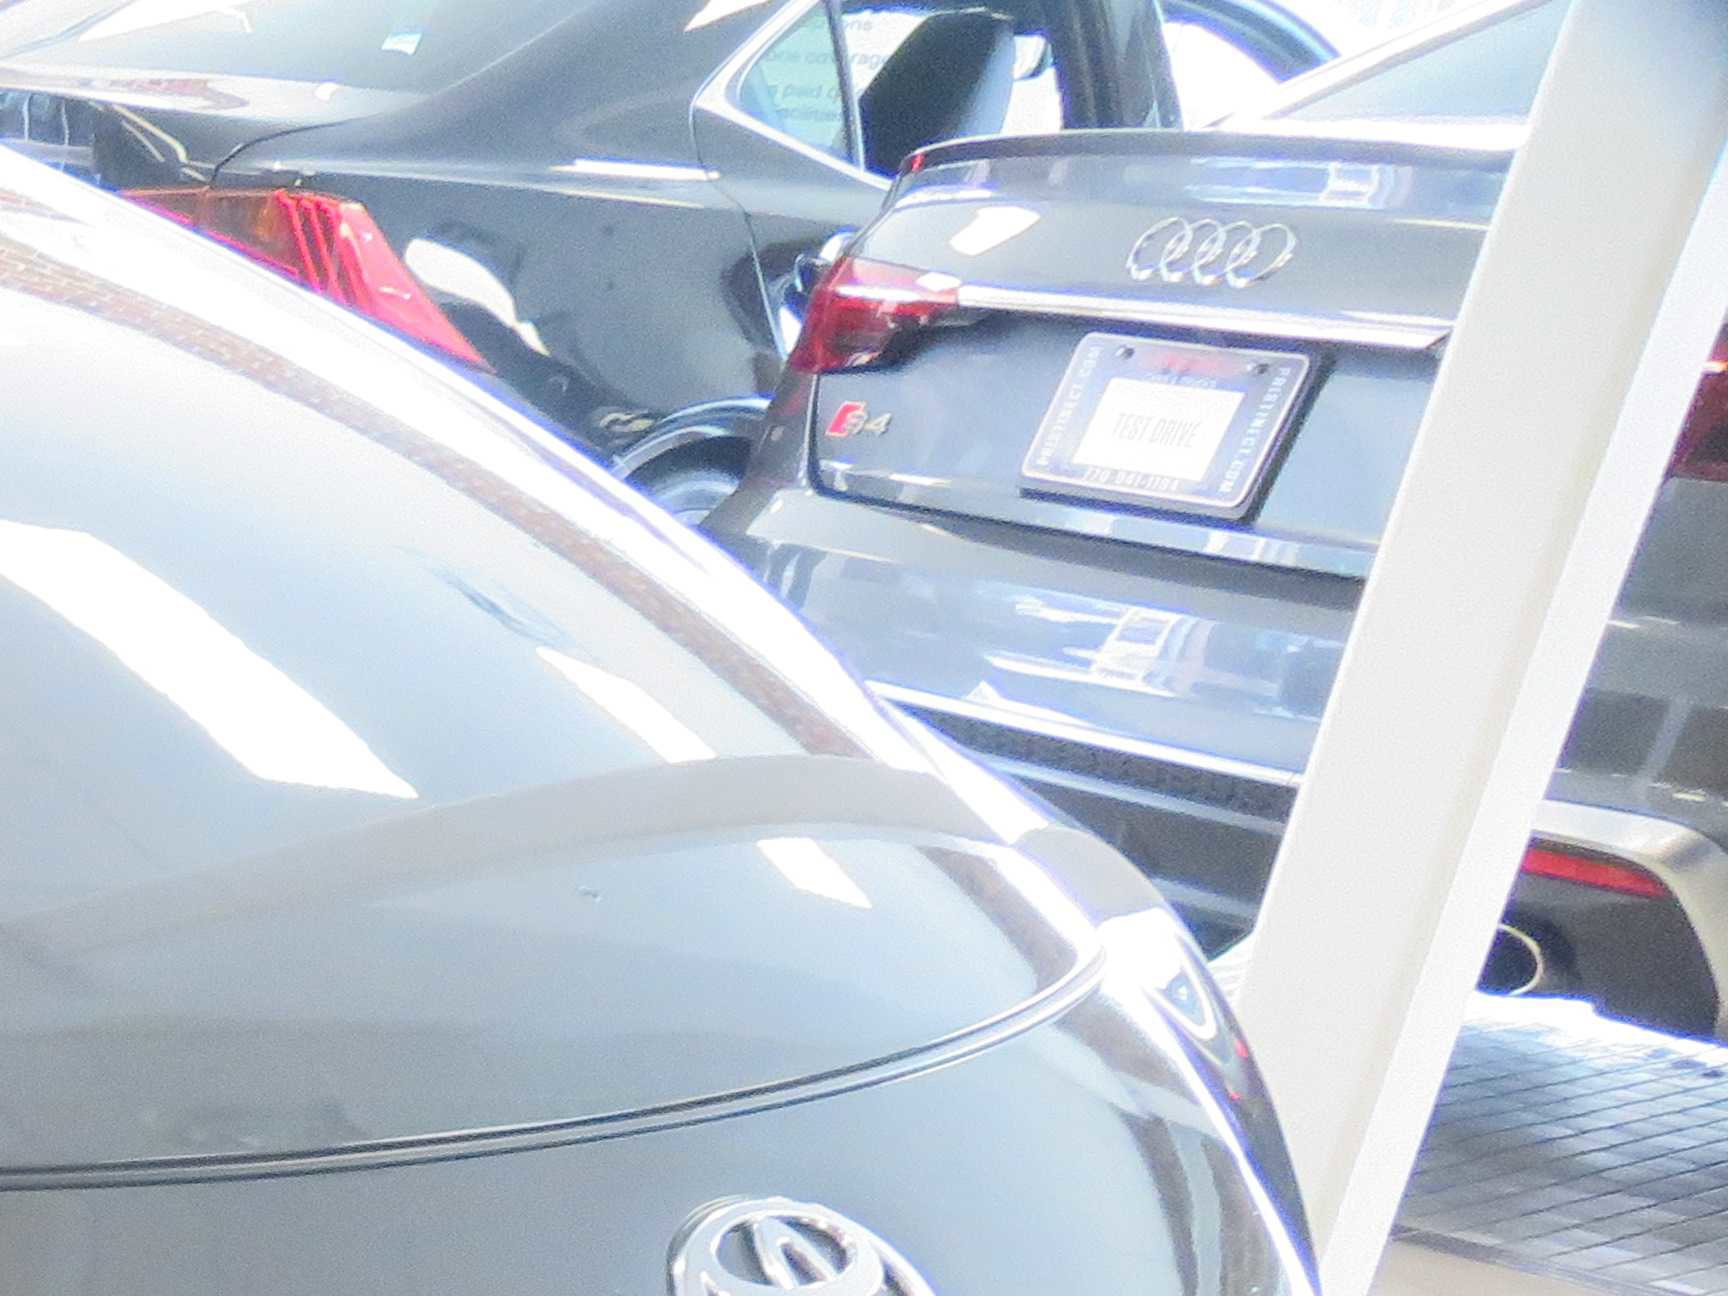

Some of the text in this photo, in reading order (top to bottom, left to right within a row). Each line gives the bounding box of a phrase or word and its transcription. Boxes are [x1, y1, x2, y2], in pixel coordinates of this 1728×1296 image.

[825, 401, 892, 437] S4
[1112, 412, 1203, 448] TEST DRIVE
